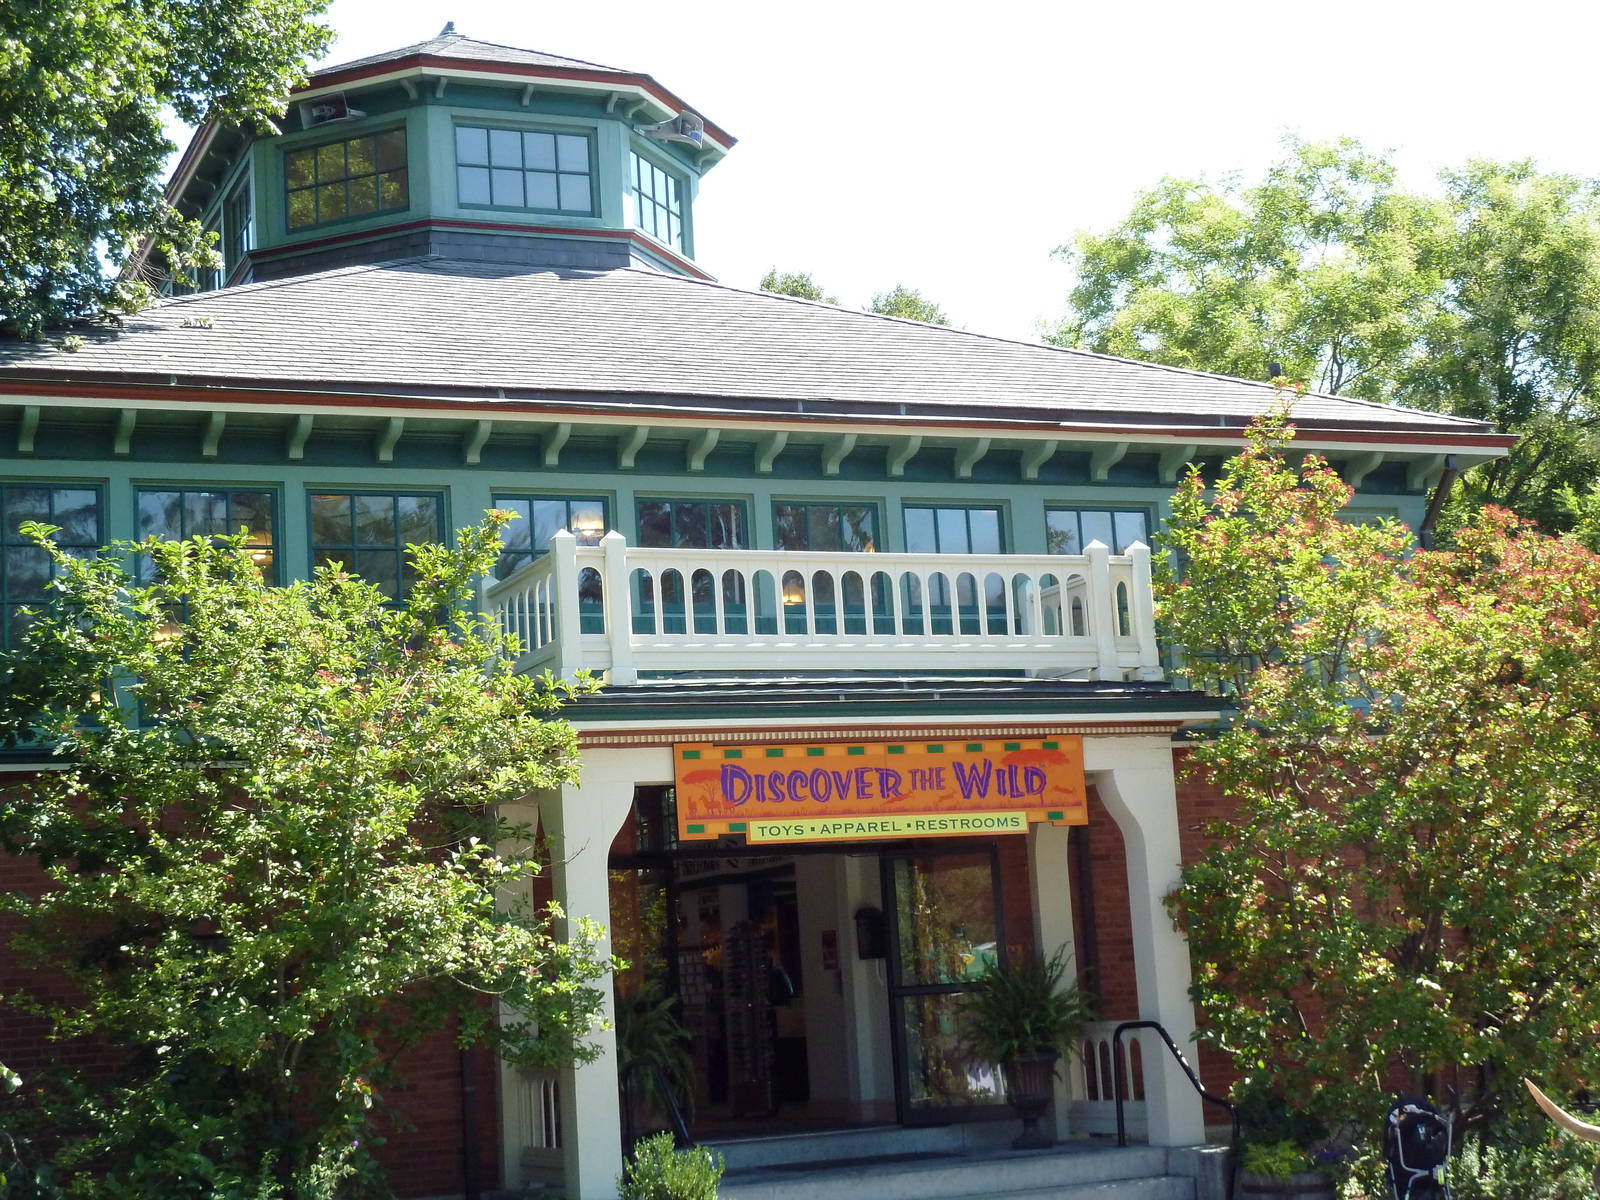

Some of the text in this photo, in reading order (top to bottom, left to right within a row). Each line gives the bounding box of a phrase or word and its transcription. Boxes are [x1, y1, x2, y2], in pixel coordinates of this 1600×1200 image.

[720, 758, 1047, 807] DISCOVER THE WILD
[758, 816, 1021, 837] TOYS APPAREL RESTROOMS
